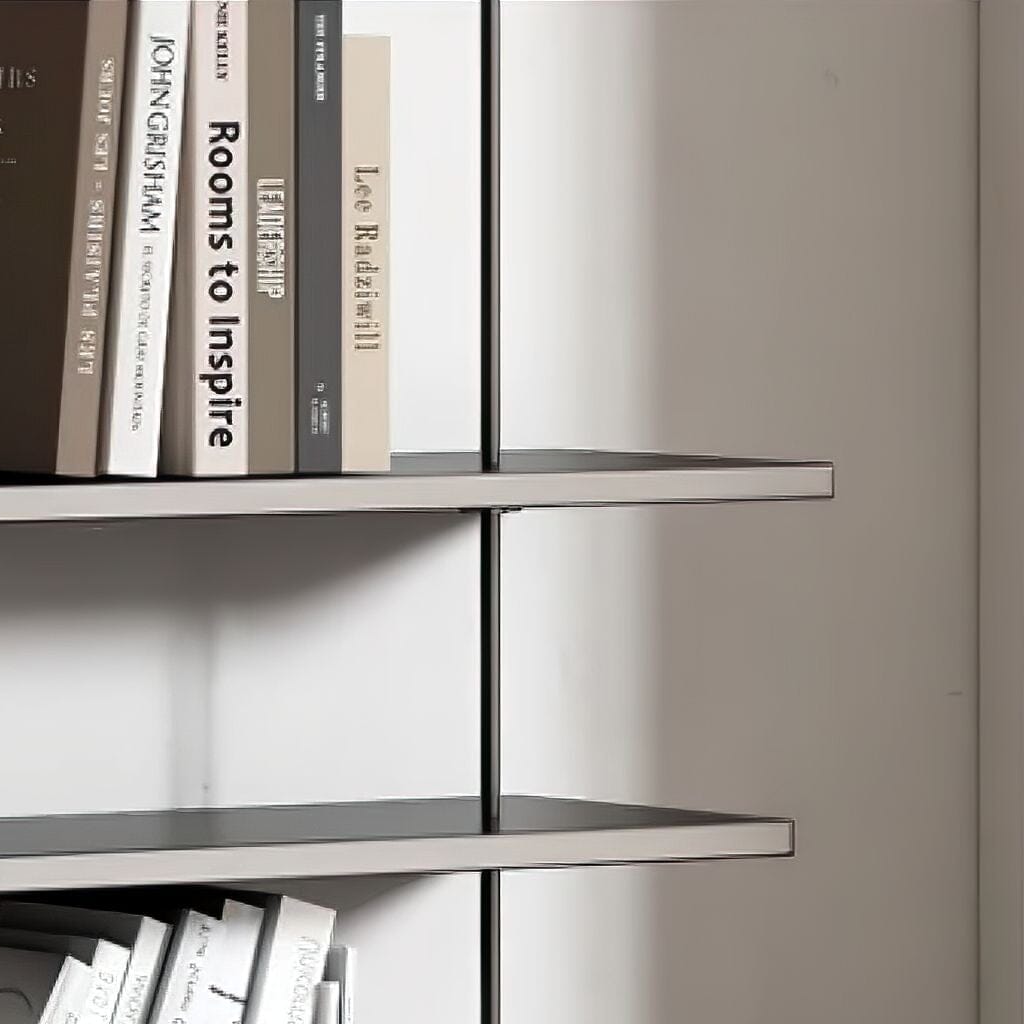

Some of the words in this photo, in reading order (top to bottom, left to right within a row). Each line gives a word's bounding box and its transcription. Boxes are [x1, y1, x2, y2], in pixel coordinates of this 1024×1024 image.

[208, 121, 241, 250] Rooms
[354, 166, 380, 213] Lee
[77, 330, 97, 375] LES
[92, 132, 109, 172] LES
[208, 260, 239, 304] to
[354, 224, 381, 350] Radziwill
[199, 315, 243, 448] Inspire
